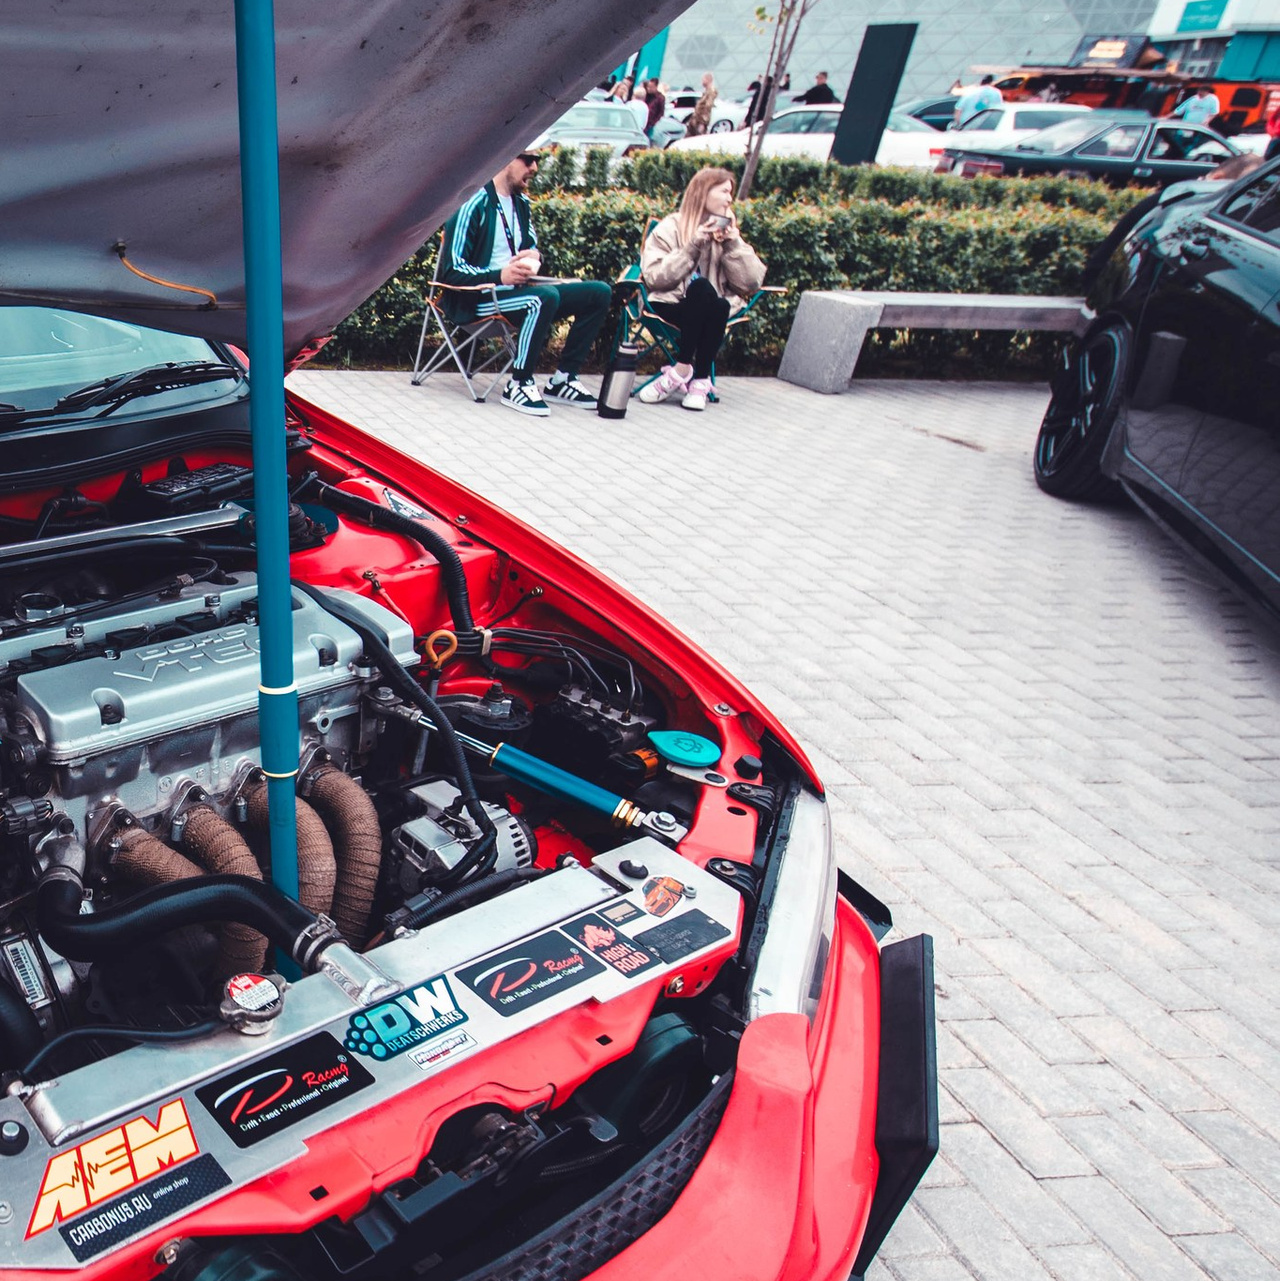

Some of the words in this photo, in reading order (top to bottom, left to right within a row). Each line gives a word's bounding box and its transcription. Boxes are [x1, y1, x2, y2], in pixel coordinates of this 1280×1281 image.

[136, 628, 248, 661] DOHC
[543, 954, 584, 974] Racing
[600, 943, 631, 963] HIGH
[614, 951, 651, 974] ROAD
[365, 978, 456, 1043] DW
[386, 1009, 464, 1052] DEATSCHWERKS
[302, 1062, 349, 1088] Racing
[240, 1118, 259, 1132] Drift
[281, 1089, 321, 1111] Professional
[322, 1075, 350, 1093] Original
[26, 1098, 199, 1240] AEM
[69, 1193, 153, 1246] CARBONUS.RU
[173, 1176, 190, 1193] shop
